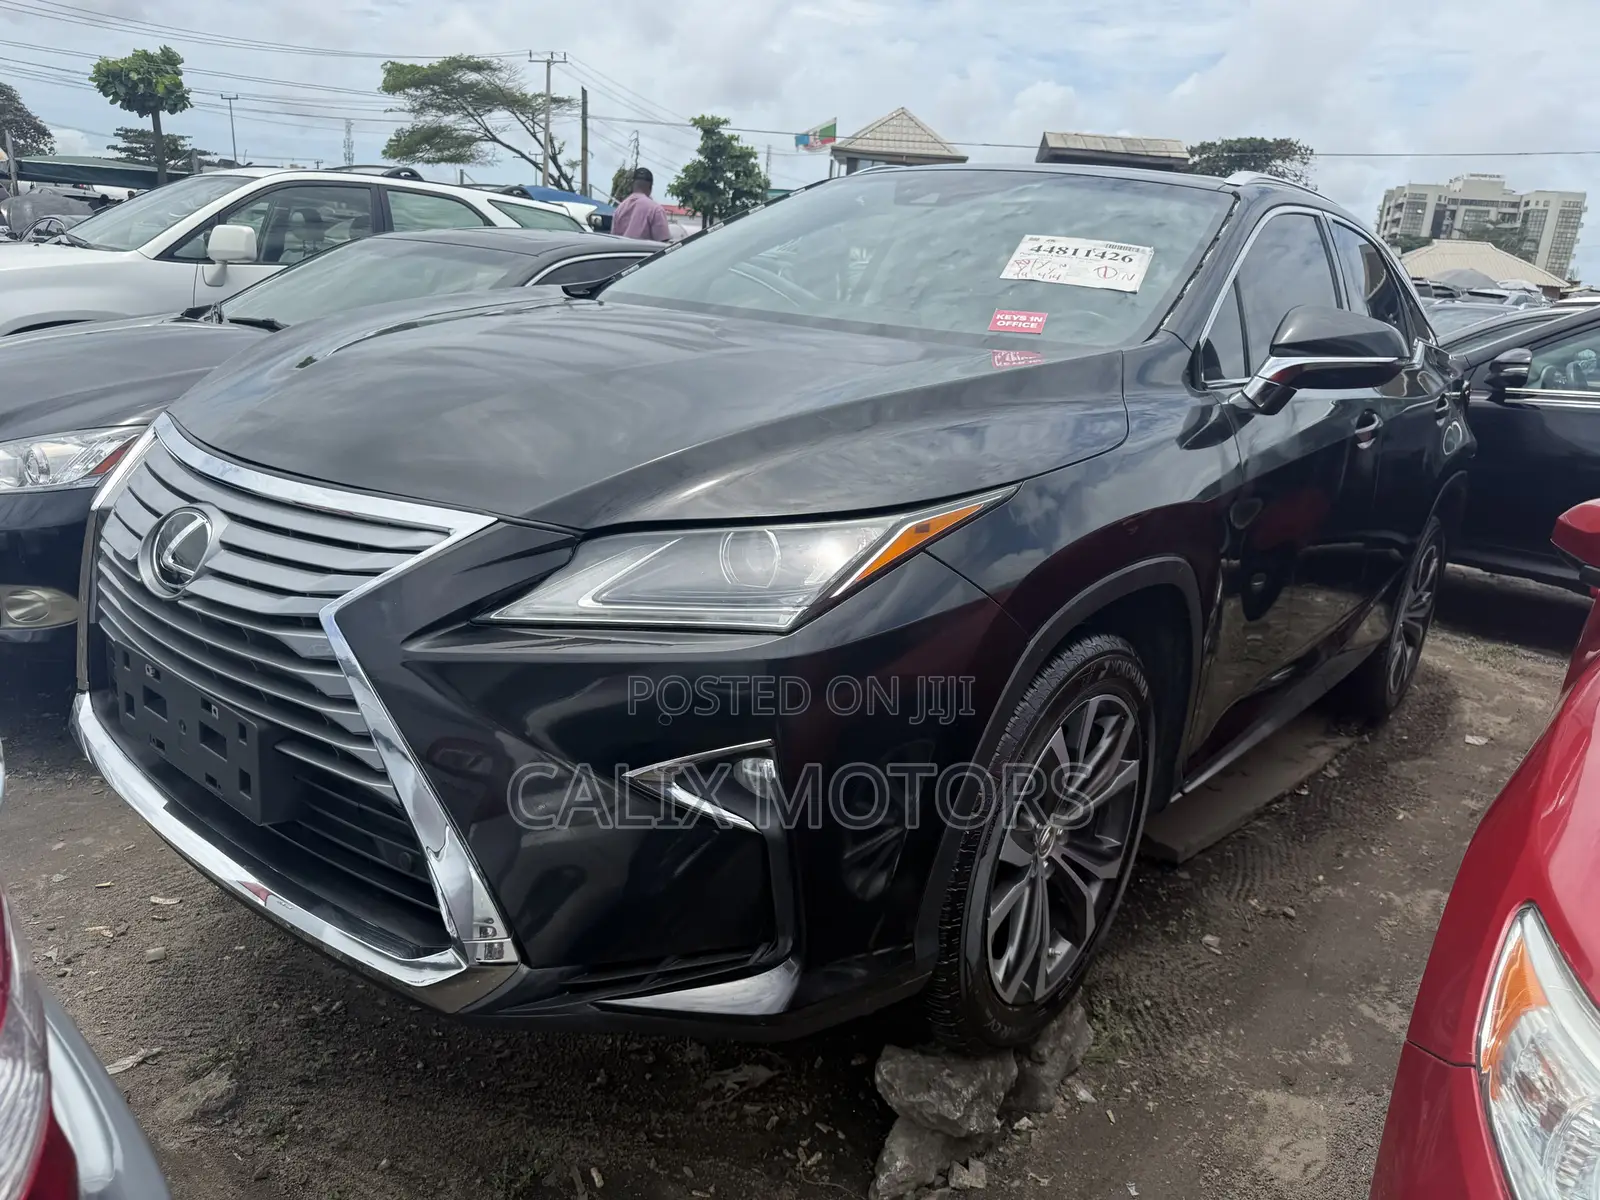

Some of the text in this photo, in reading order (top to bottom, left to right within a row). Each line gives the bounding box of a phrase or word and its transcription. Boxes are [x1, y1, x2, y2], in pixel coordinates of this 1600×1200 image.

[1029, 244, 1134, 264] 44811426
[1028, 315, 1043, 323] IN
[996, 320, 1038, 329] OFFICE
